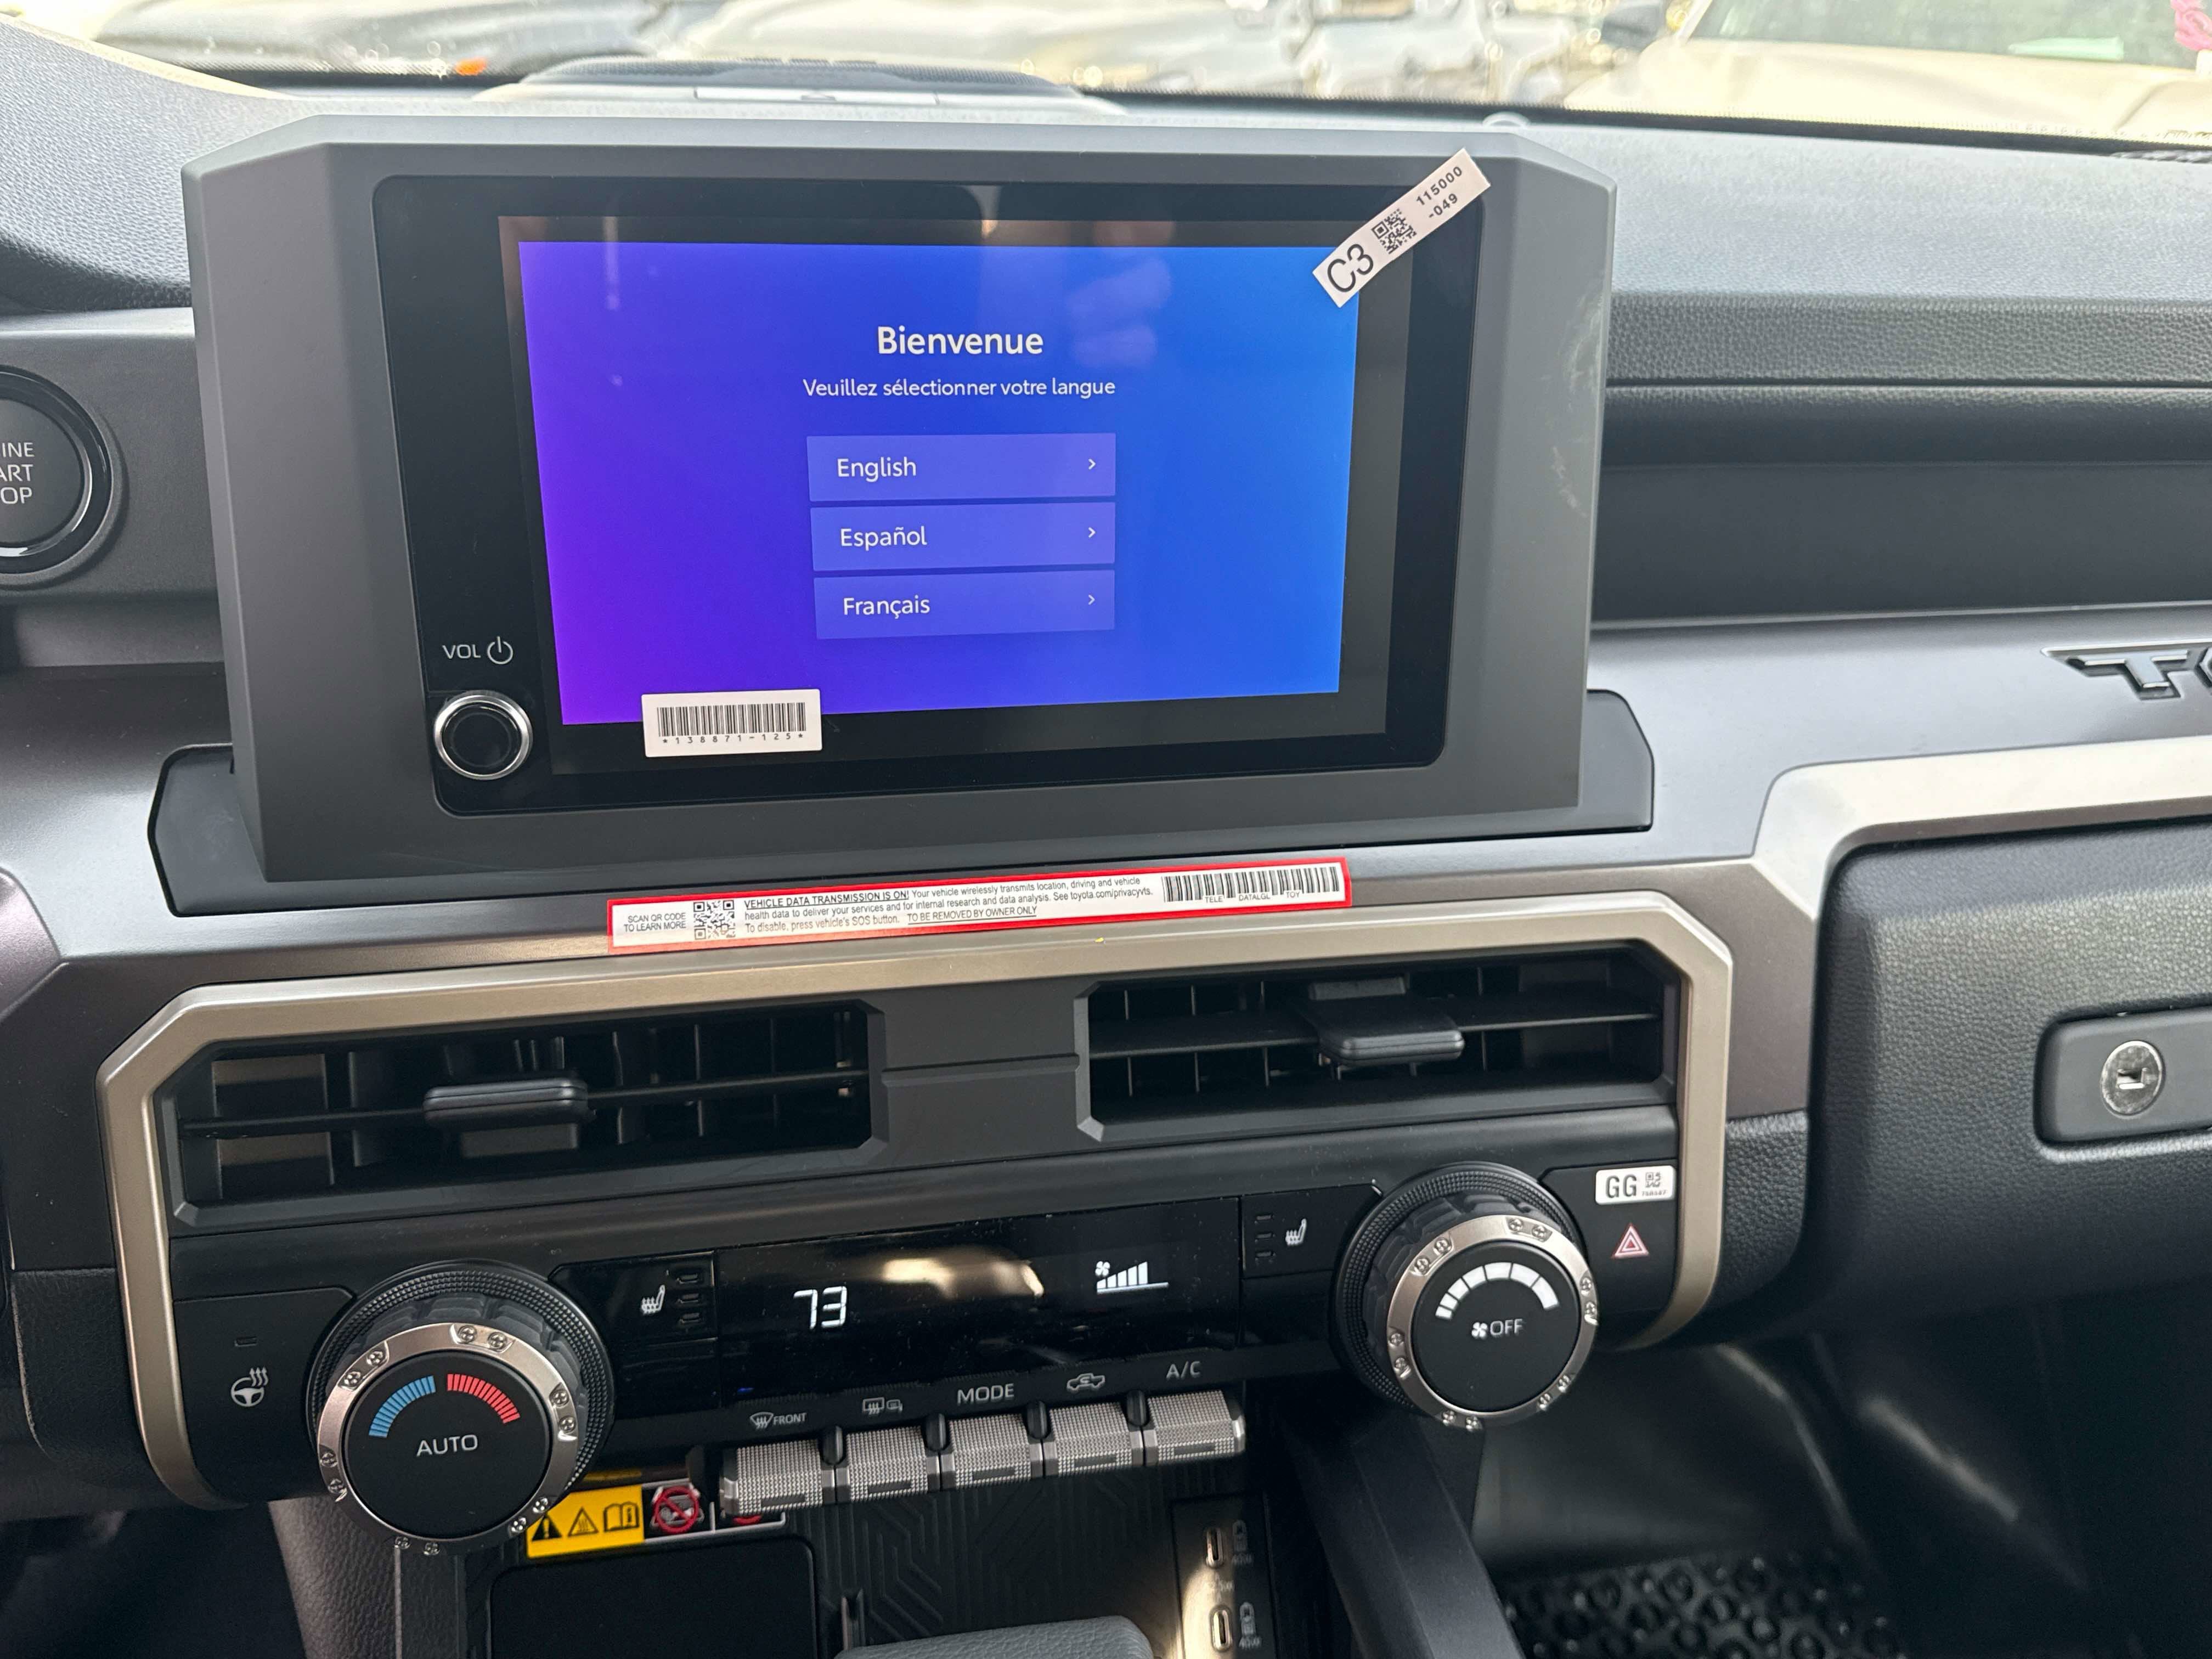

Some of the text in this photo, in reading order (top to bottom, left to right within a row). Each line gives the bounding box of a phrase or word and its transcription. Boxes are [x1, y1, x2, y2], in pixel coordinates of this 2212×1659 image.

[1417, 166, 1462, 206] 115000
[1428, 193, 1458, 218] -049
[1327, 244, 1374, 292] C3
[878, 325, 1043, 354] Bienvenue
[803, 377, 1116, 399] Veuillez sélectionner votre langue
[0, 442, 35, 457] INE
[837, 456, 917, 482] English
[840, 527, 927, 551] Español
[843, 595, 930, 619] Français
[442, 644, 481, 659] VOL
[744, 877, 1141, 908] VEHICLE DATA TRANSMISSION IS ON! Your vehicle wirelessly transmits location, driving and vehicle
[628, 912, 686, 923] SCAN QR CODE
[744, 911, 770, 921] health
[772, 909, 789, 919] data
[792, 909, 800, 917] to
[803, 906, 830, 917] deliver
[832, 906, 849, 917] your
[851, 904, 884, 913] services
[886, 902, 901, 912] and
[904, 901, 913, 911] for
[916, 899, 945, 909] internal
[947, 897, 980, 907] research
[983, 896, 997, 905] and
[999, 895, 1015, 904] data
[1018, 893, 1050, 904] analysis.
[1053, 891, 1068, 901] See
[624, 921, 686, 932] TO LEARN MORE
[746, 906, 1037, 933] To disable, press vehicle's SOS button. TO BE REMOVED BY OWNER ONLY
[1606, 1173, 1637, 1198] GG
[793, 1285, 847, 1329] 73
[1490, 1319, 1523, 1336] OFF
[1166, 1362, 1200, 1379] A/C
[957, 1384, 1014, 1405] MODE
[774, 1413, 806, 1425] FRONT
[417, 1434, 478, 1456] AUTO
